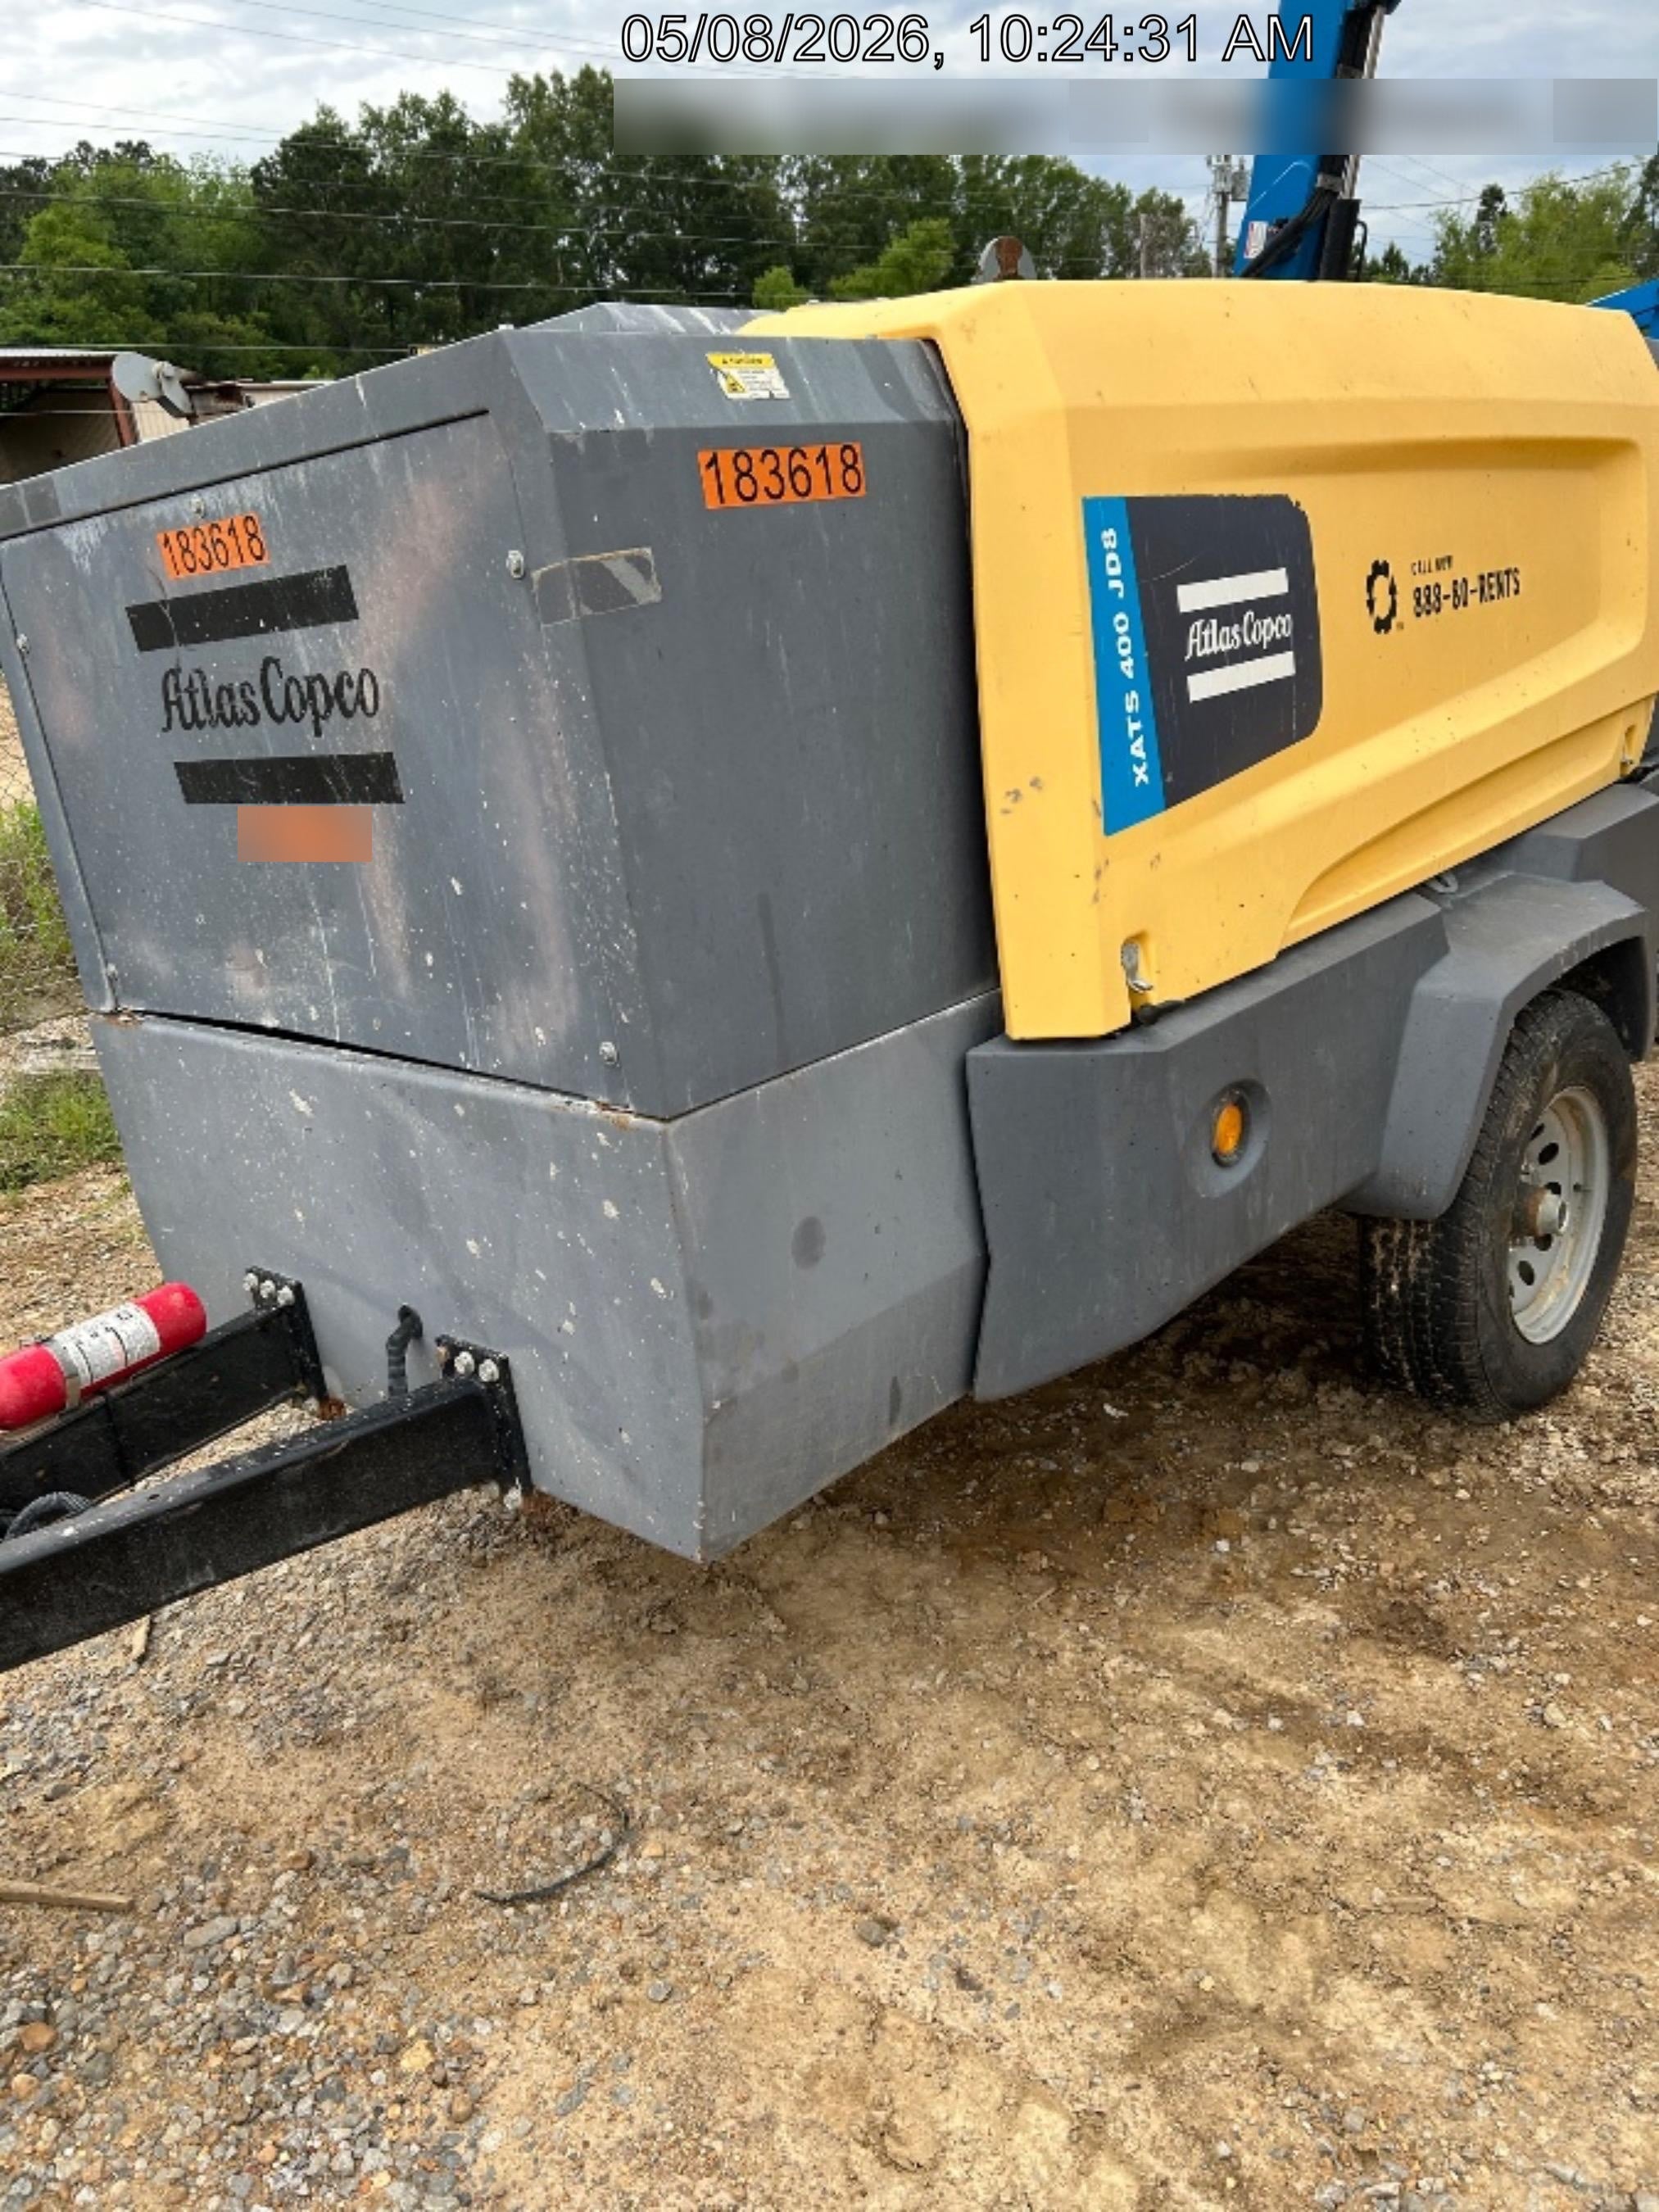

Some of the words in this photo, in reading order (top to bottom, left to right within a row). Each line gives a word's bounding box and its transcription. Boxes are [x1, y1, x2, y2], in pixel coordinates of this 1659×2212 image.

[705, 443, 862, 505] 183618
[162, 514, 266, 576] 183618
[1113, 611, 1135, 680] 400
[1184, 618, 1242, 663] Atlas
[1242, 609, 1293, 650] Copco
[161, 666, 261, 733] Atlas
[260, 656, 380, 738] Copco
[1124, 690, 1149, 788] XATS
